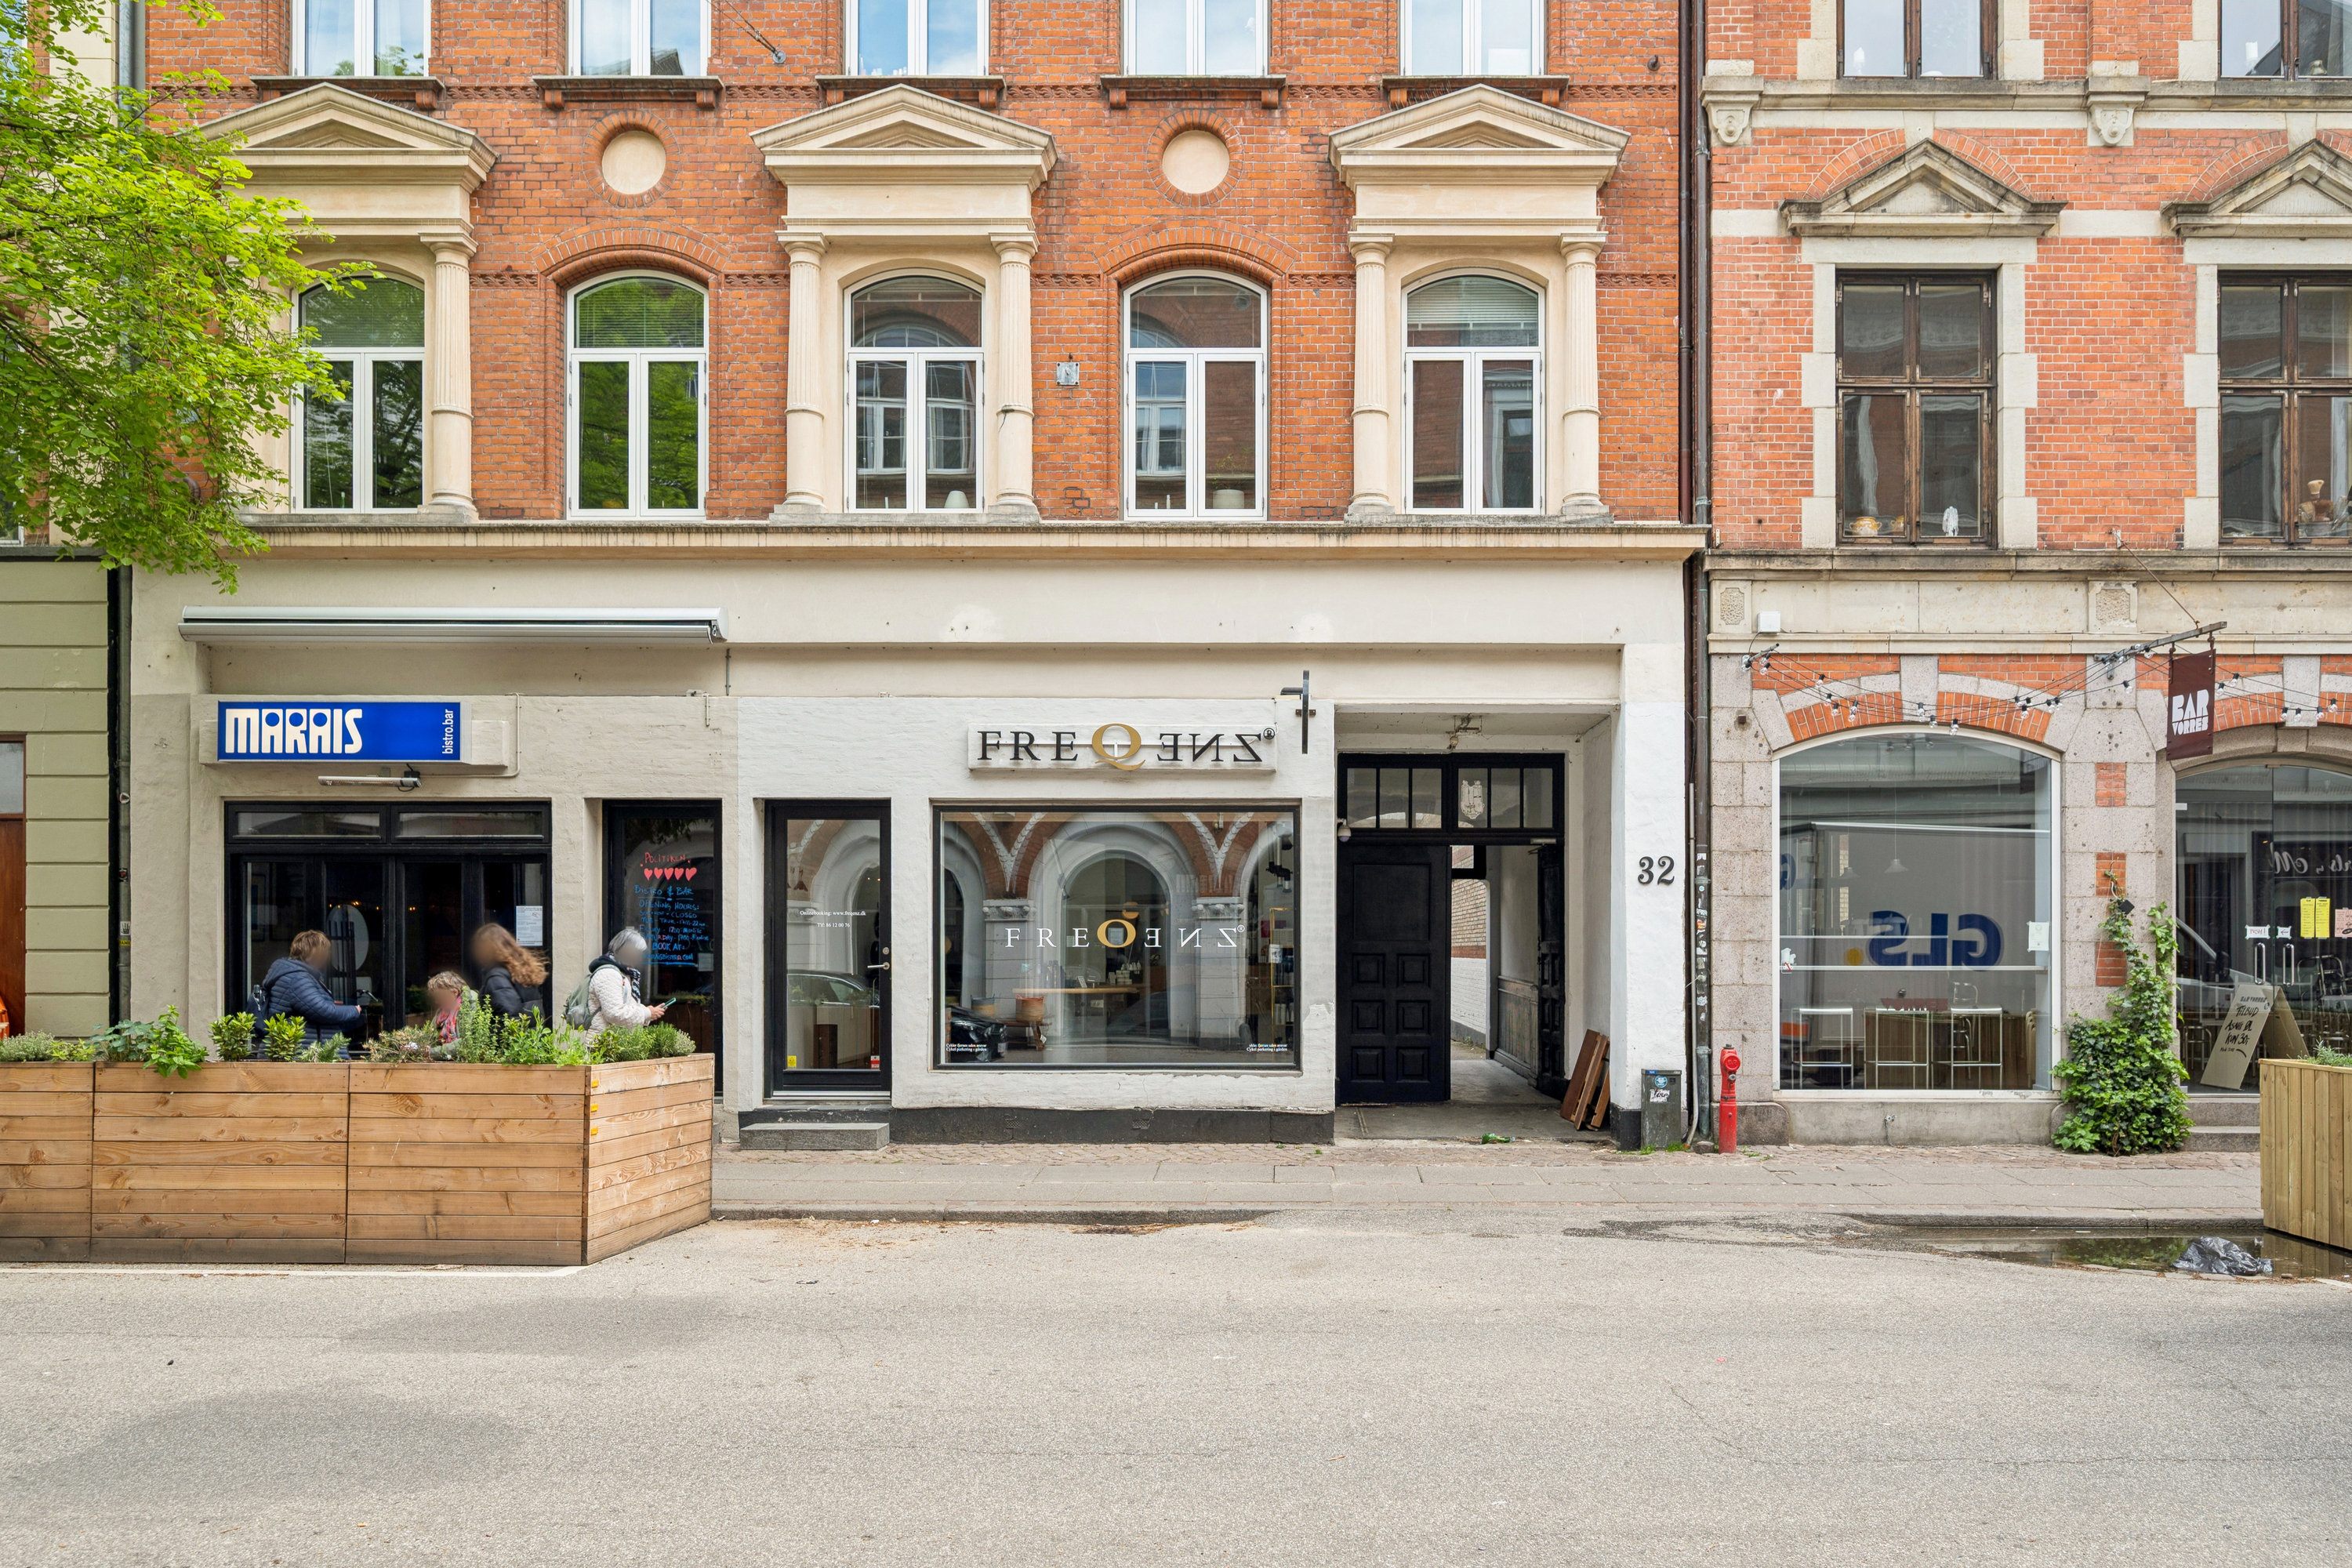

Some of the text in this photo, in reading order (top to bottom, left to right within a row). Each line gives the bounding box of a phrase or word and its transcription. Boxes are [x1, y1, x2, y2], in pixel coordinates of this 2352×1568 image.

[2172, 689, 2209, 723] BAR
[225, 708, 363, 754] MARAIS
[441, 709, 454, 755] bistro.bar
[1638, 855, 1675, 885] 32
[676, 887, 695, 895] BAR
[652, 942, 671, 951] BOOK
[2236, 1005, 2259, 1018] TILBUD
